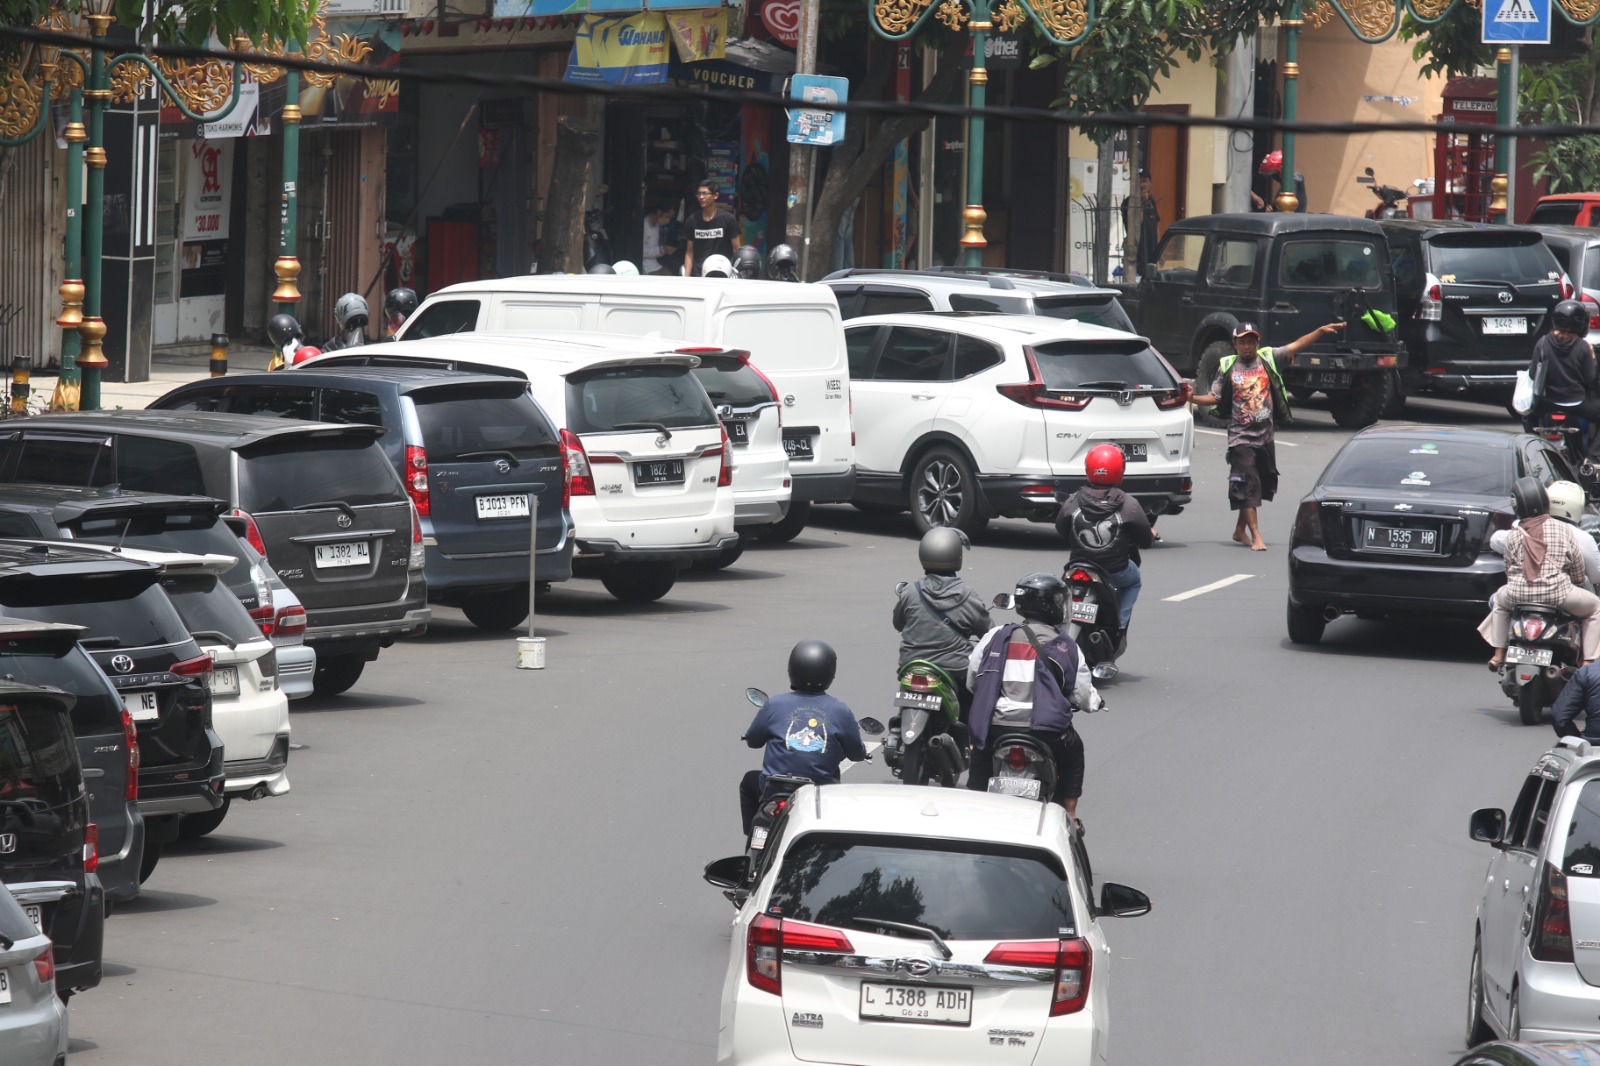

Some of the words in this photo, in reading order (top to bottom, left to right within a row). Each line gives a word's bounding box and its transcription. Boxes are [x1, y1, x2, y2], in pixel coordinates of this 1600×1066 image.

[618, 24, 665, 46] WAHANA
[693, 69, 755, 89] VOUCHER
[1482, 318, 1488, 328] N
[1494, 317, 1513, 329] 1442
[1307, 373, 1313, 382] N
[1320, 373, 1337, 383] 1432
[636, 465, 642, 477] N
[650, 464, 668, 476] 1822
[479, 498, 485, 511] B
[510, 495, 526, 508] PFN
[1368, 528, 1375, 540] N
[1388, 530, 1412, 543] 1535
[316, 547, 323, 560] N
[330, 545, 351, 558] 1382
[357, 543, 368, 556] AL
[141, 694, 155, 710] NE
[895, 691, 901, 699] N
[903, 692, 923, 701] 3928
[866, 986, 875, 1004] L
[885, 987, 927, 1007] 1388
[936, 991, 967, 1010] ADH
[792, 1012, 824, 1021] ASTRA
